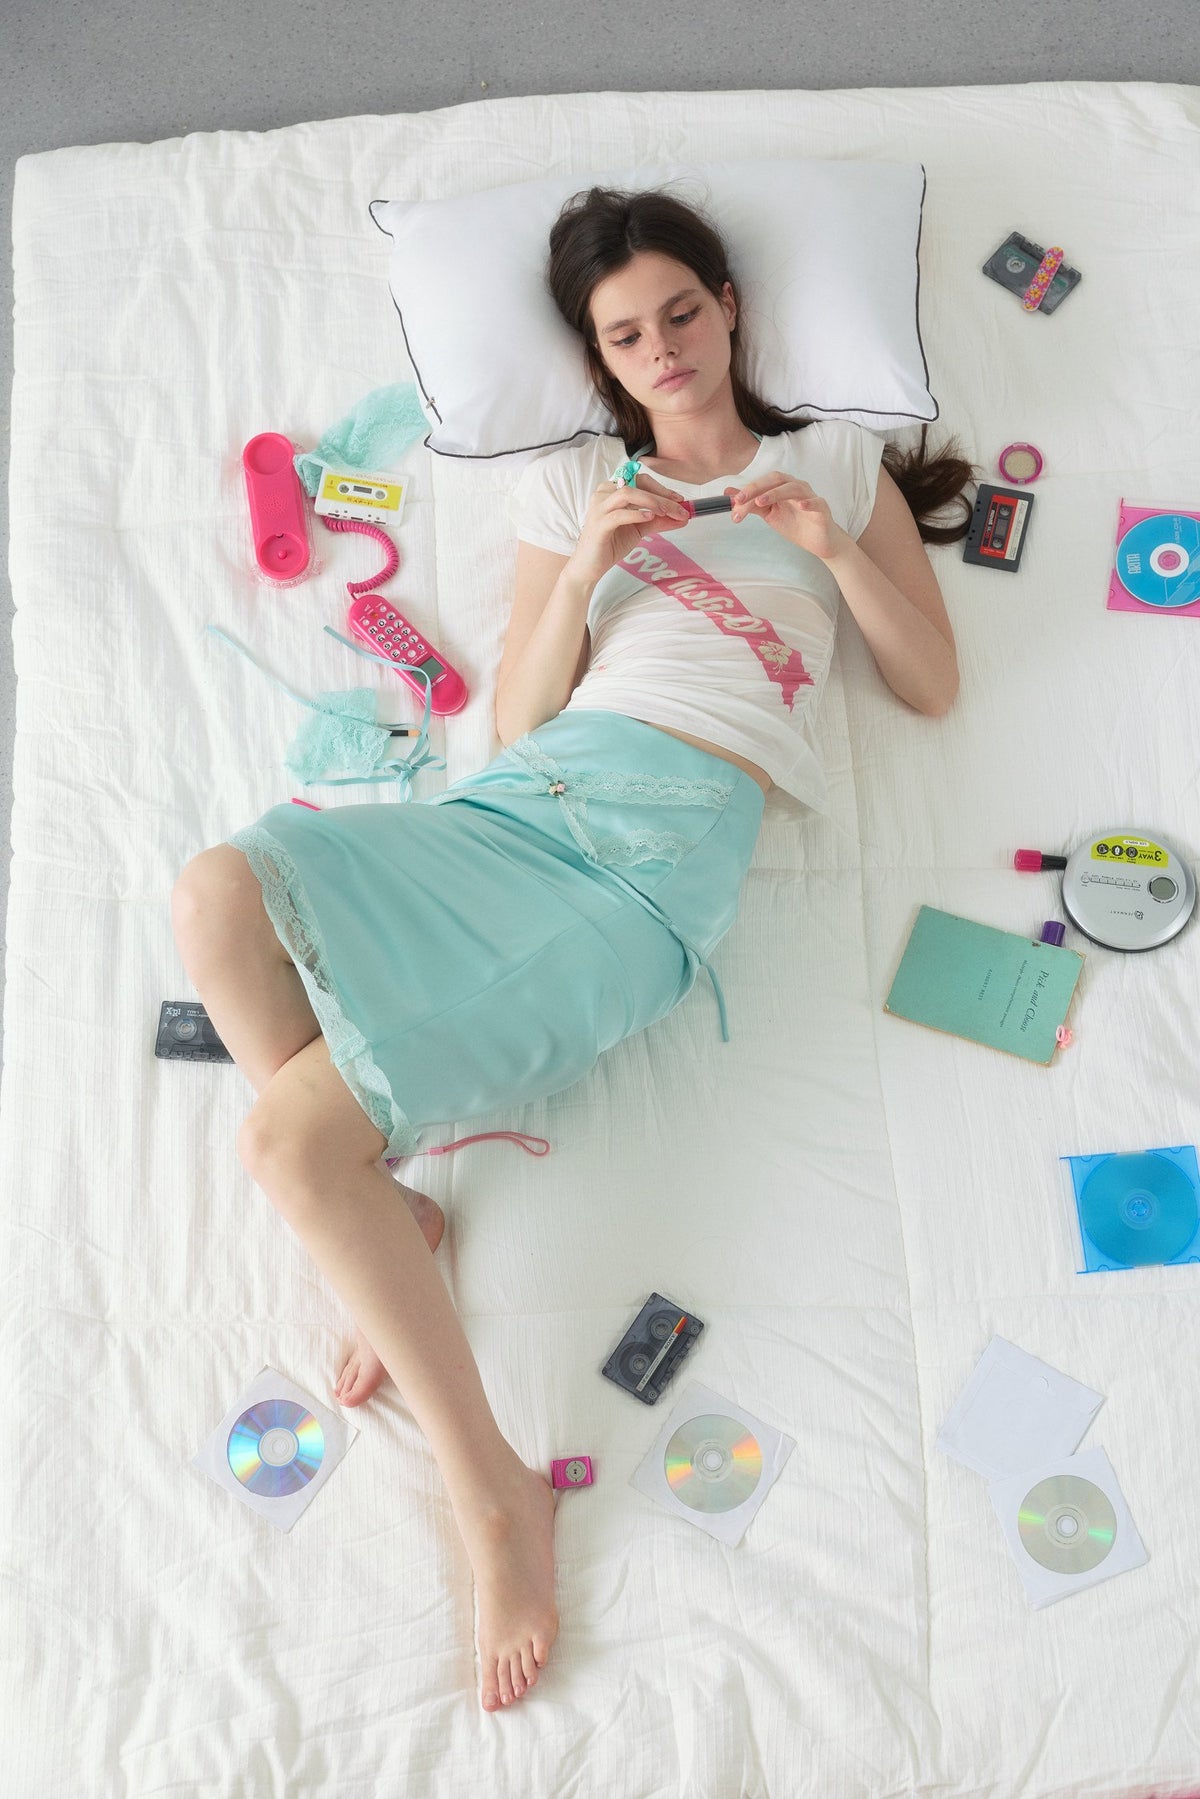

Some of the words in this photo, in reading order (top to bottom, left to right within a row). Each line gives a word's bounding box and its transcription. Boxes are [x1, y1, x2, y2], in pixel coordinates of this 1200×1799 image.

[624, 537, 679, 582] ove
[1154, 850, 1162, 862] 3
[1035, 970, 1050, 989] Pick
[1029, 989, 1039, 1008] and
[1020, 1007, 1036, 1033] Choose
